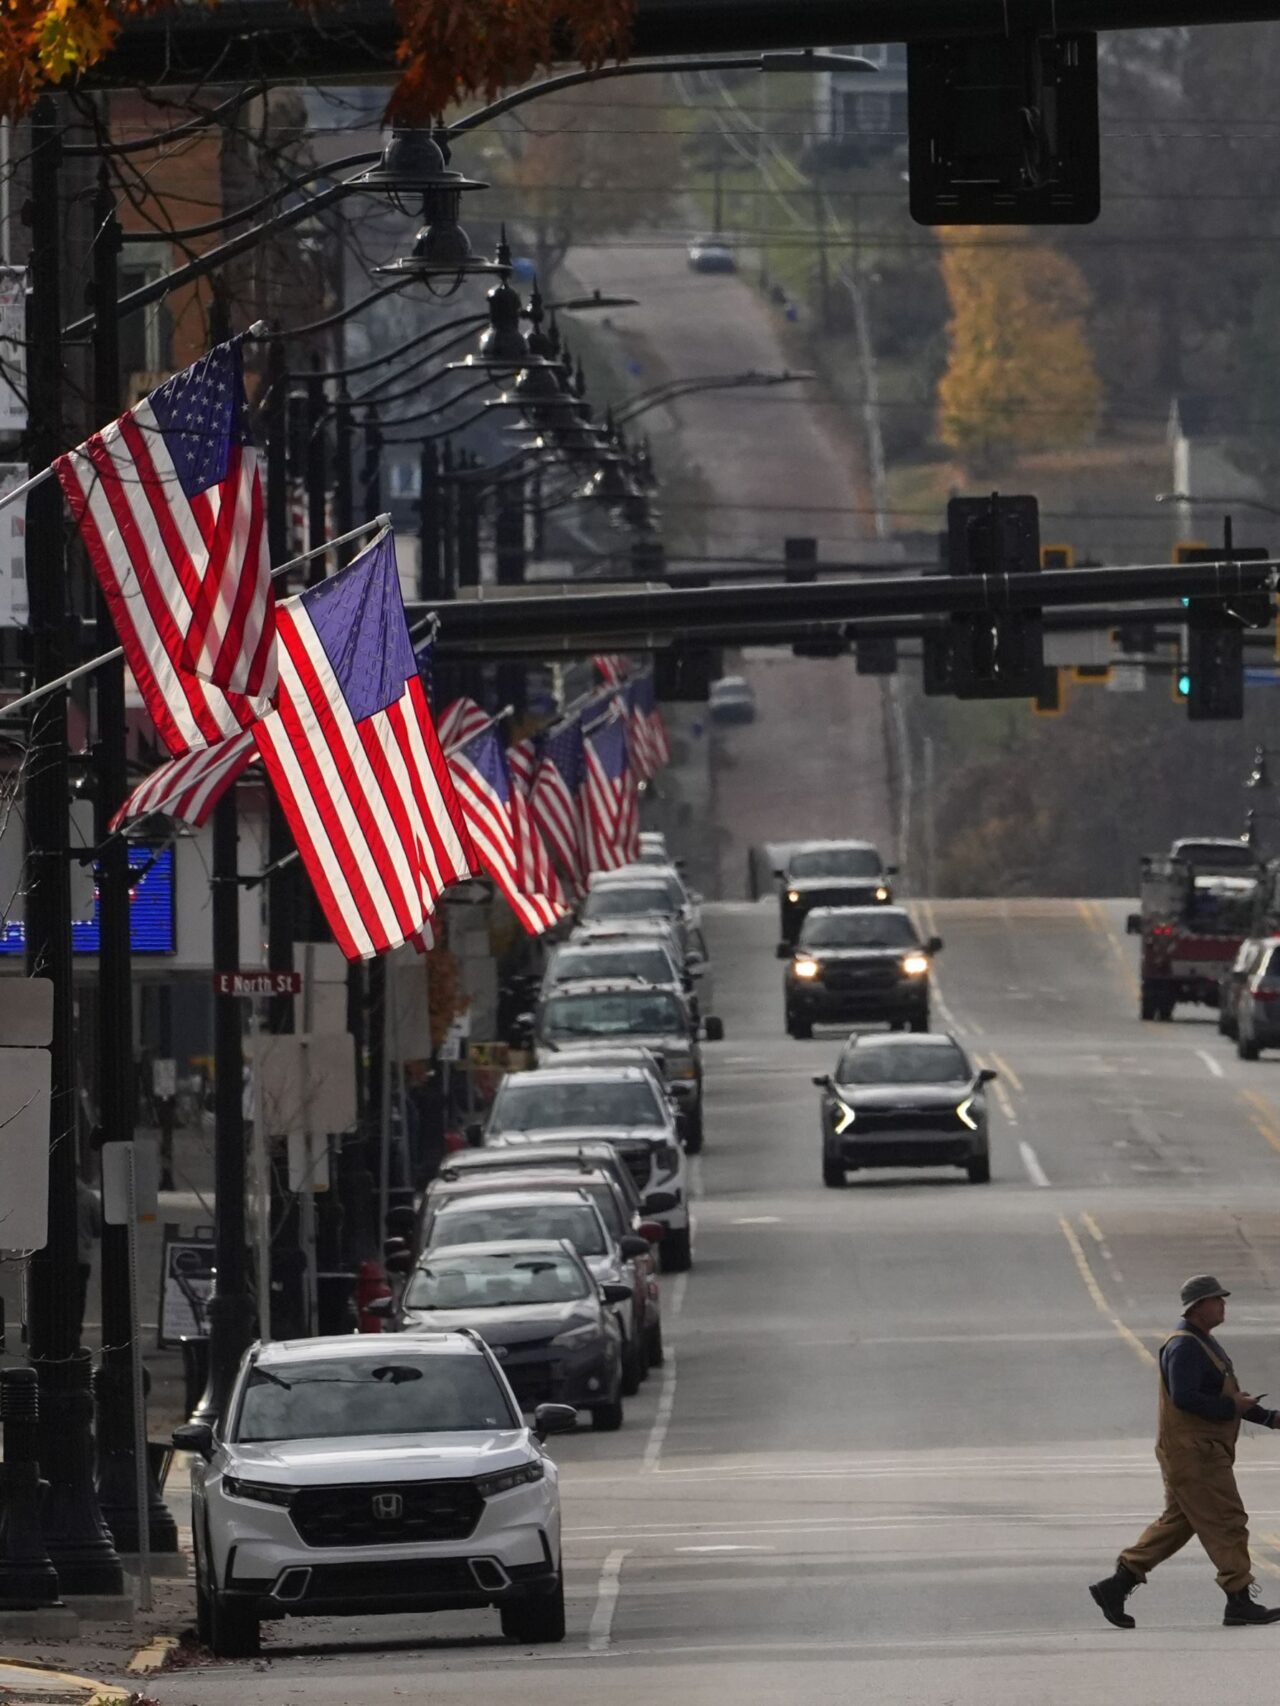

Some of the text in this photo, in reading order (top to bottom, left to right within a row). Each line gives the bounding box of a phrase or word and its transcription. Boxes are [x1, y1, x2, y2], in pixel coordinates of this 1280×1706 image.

[221, 975, 293, 993] E North St
